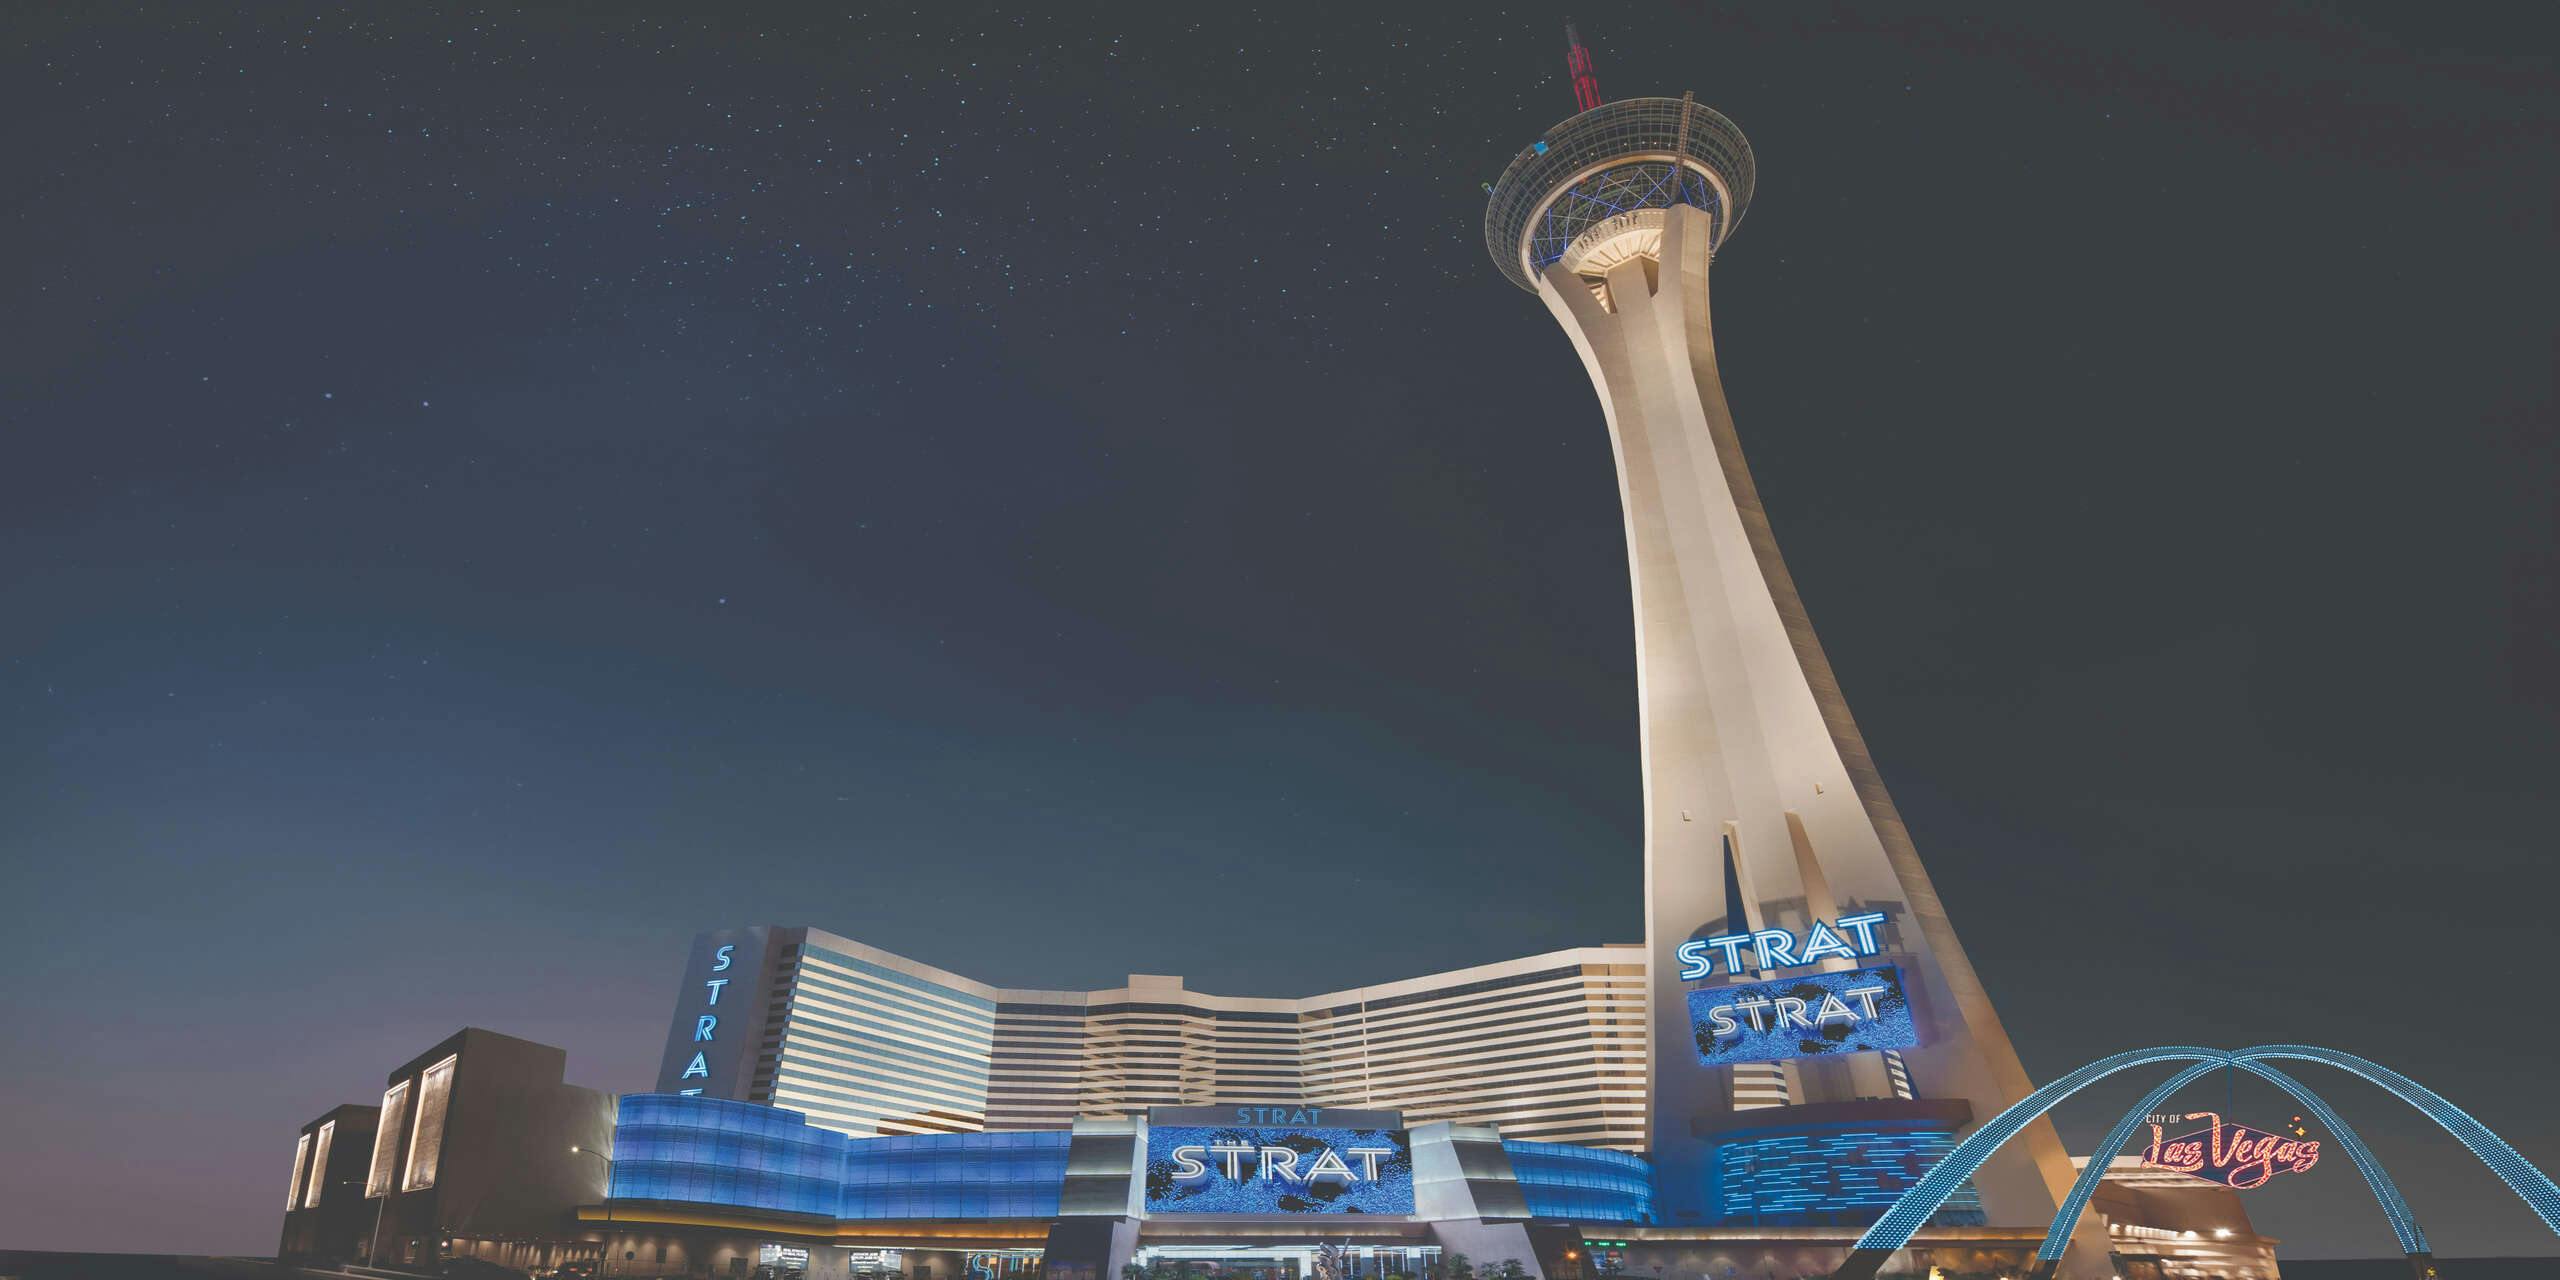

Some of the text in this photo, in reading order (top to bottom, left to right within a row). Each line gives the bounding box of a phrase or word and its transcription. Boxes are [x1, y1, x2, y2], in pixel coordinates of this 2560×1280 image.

[1677, 912, 1886, 980] STRAT
[679, 944, 735, 1096] STRA
[1708, 986, 1885, 1036] STRAT
[1236, 1107, 1322, 1126] STRAT
[2145, 1114, 2181, 1124] CITY OF
[1171, 1145, 1392, 1183] STRAT
[2140, 1112, 2320, 1189] Las Vegas
